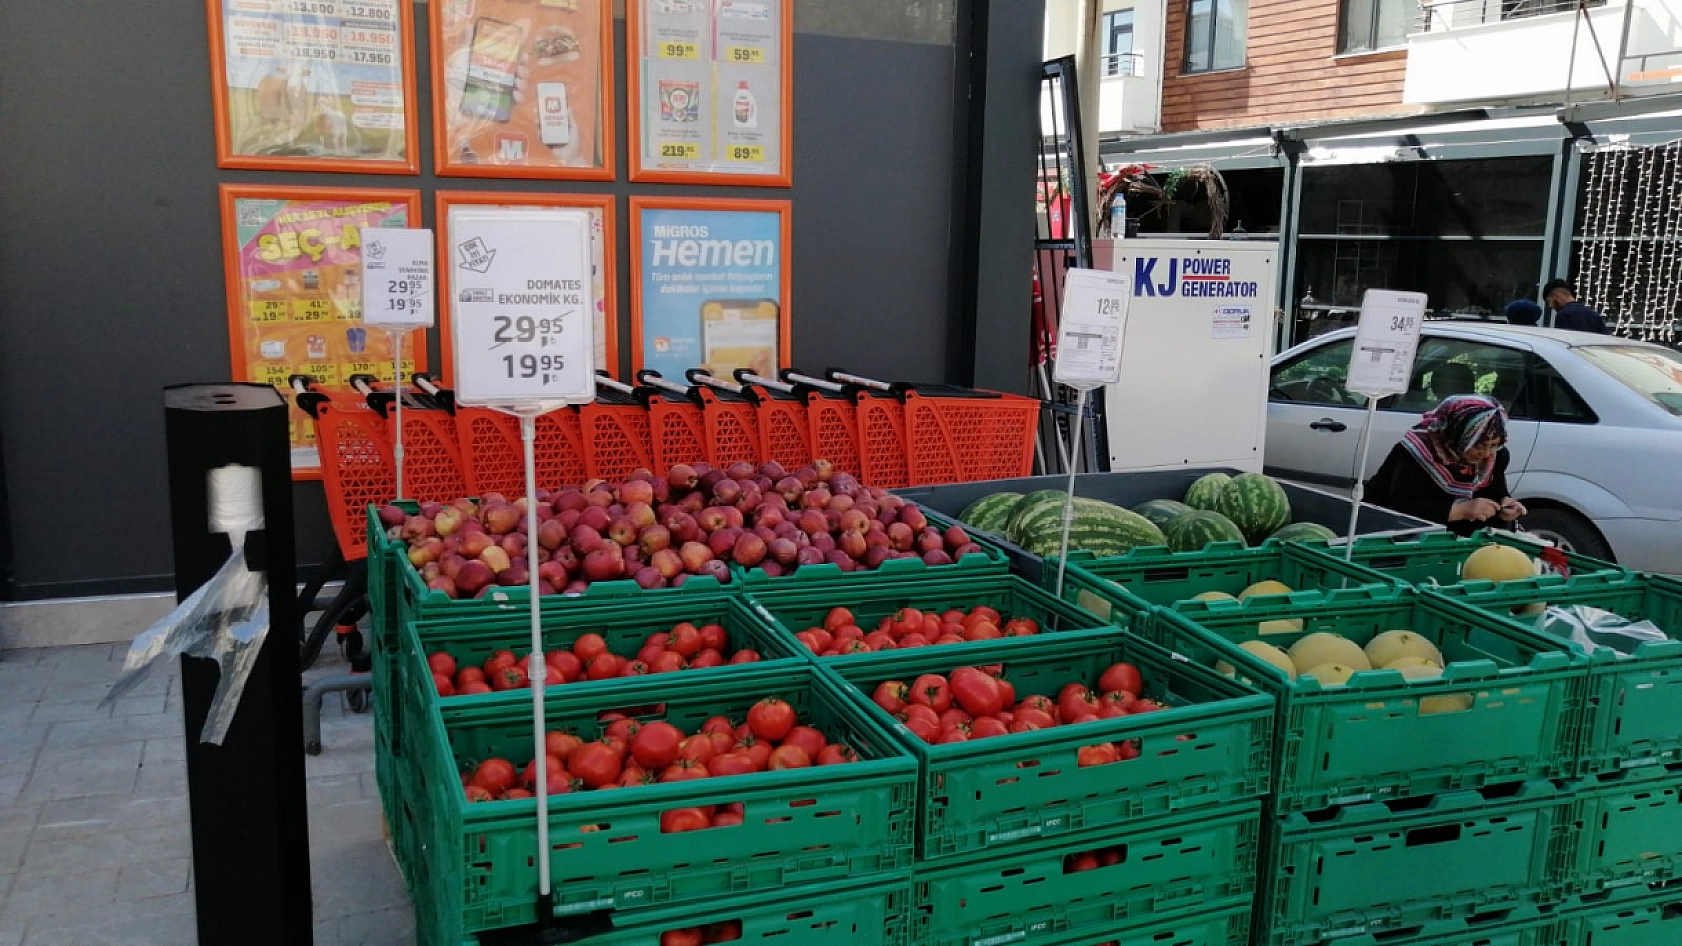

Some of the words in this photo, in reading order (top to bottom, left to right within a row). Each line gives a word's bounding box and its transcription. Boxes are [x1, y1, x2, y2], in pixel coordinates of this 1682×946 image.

[649, 239, 774, 267] Hemen
[527, 279, 582, 291] DOMATES
[1134, 257, 1177, 297] KJ
[1182, 258, 1231, 274] POWER
[1182, 280, 1257, 298] GENERATOR
[498, 293, 558, 305] EKONOMİK
[563, 293, 584, 305] KG.
